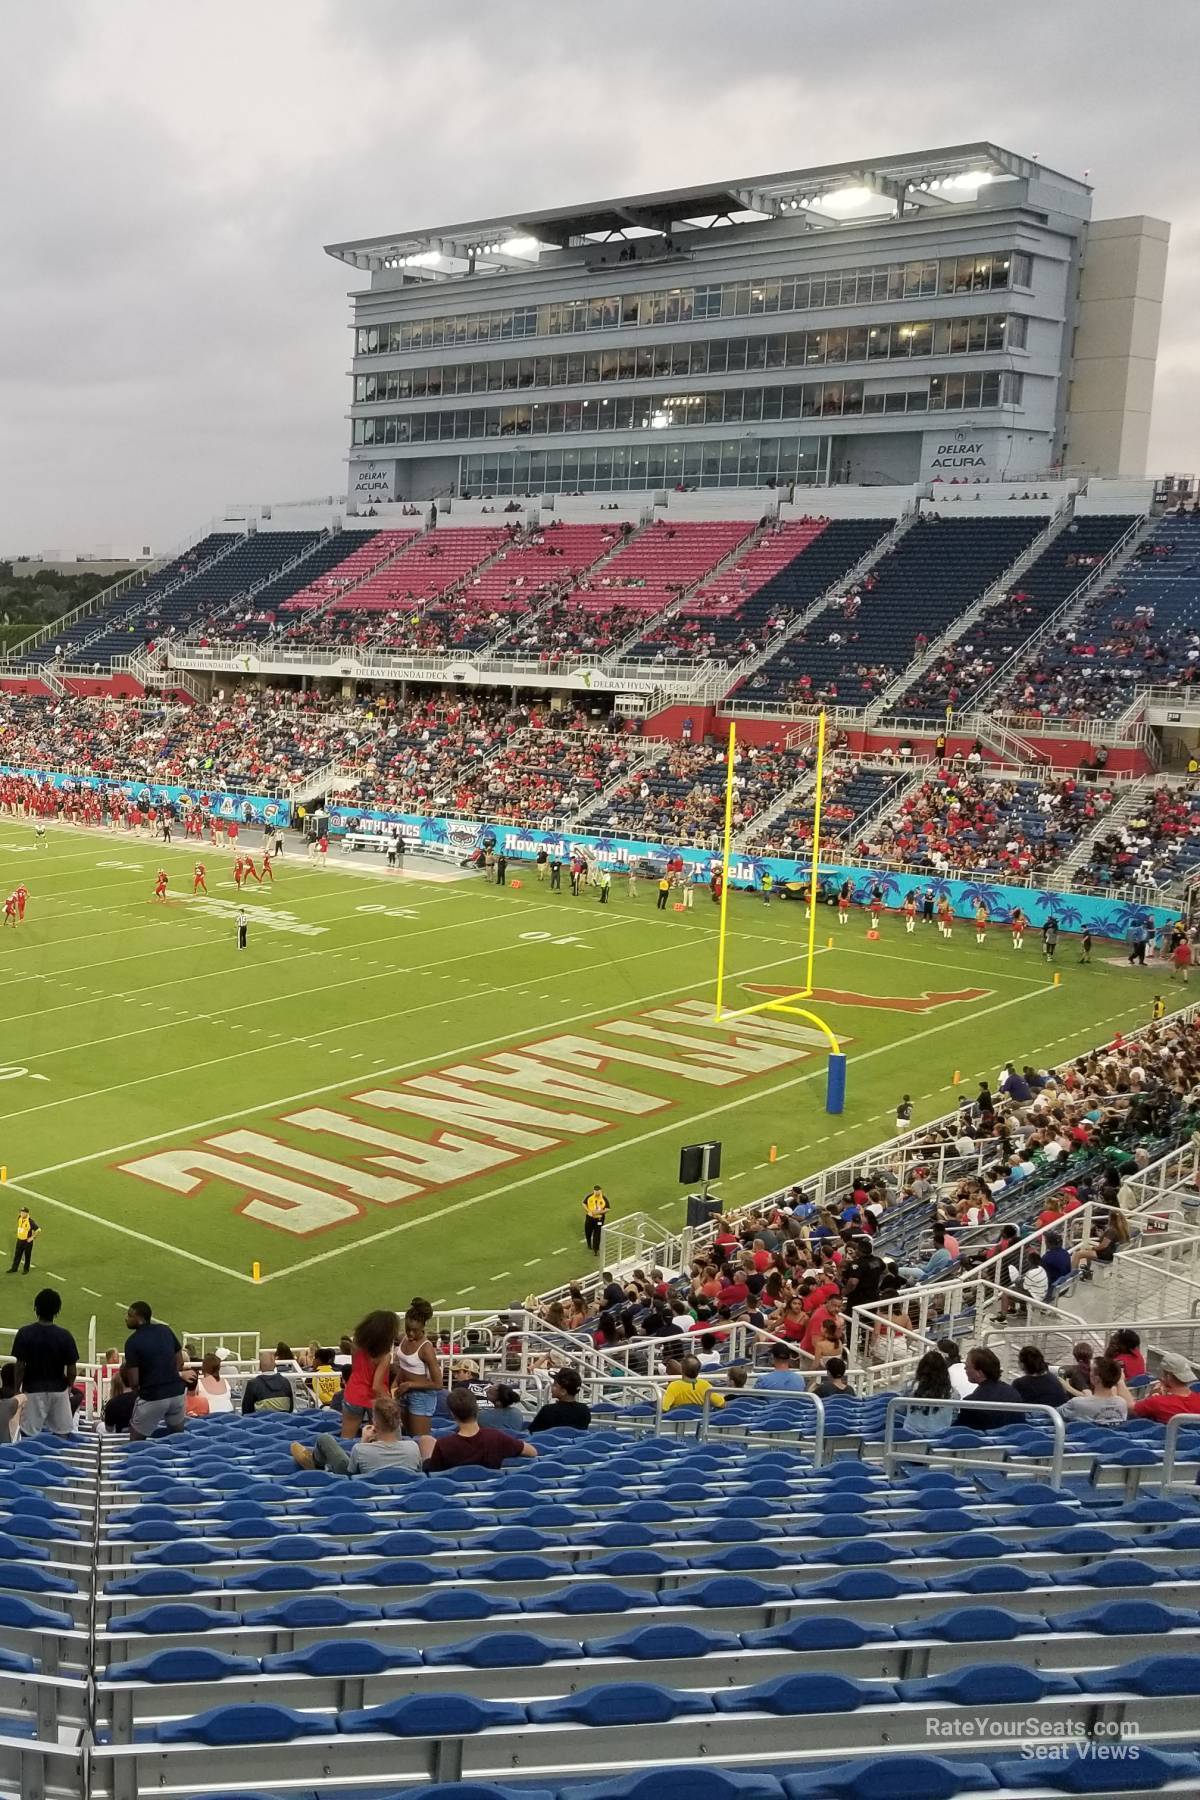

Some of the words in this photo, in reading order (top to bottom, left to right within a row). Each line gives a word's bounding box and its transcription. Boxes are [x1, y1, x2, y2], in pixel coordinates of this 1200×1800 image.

[937, 443, 984, 455] DELRAY
[930, 457, 987, 468] ACURA
[359, 471, 388, 480] DELRAY
[355, 481, 389, 490] ACURA
[355, 668, 386, 677] DELRAY
[387, 669, 426, 678] HYUNDAI
[426, 672, 449, 680] DECK
[593, 680, 626, 688] DELRAY
[505, 833, 564, 856] Howard
